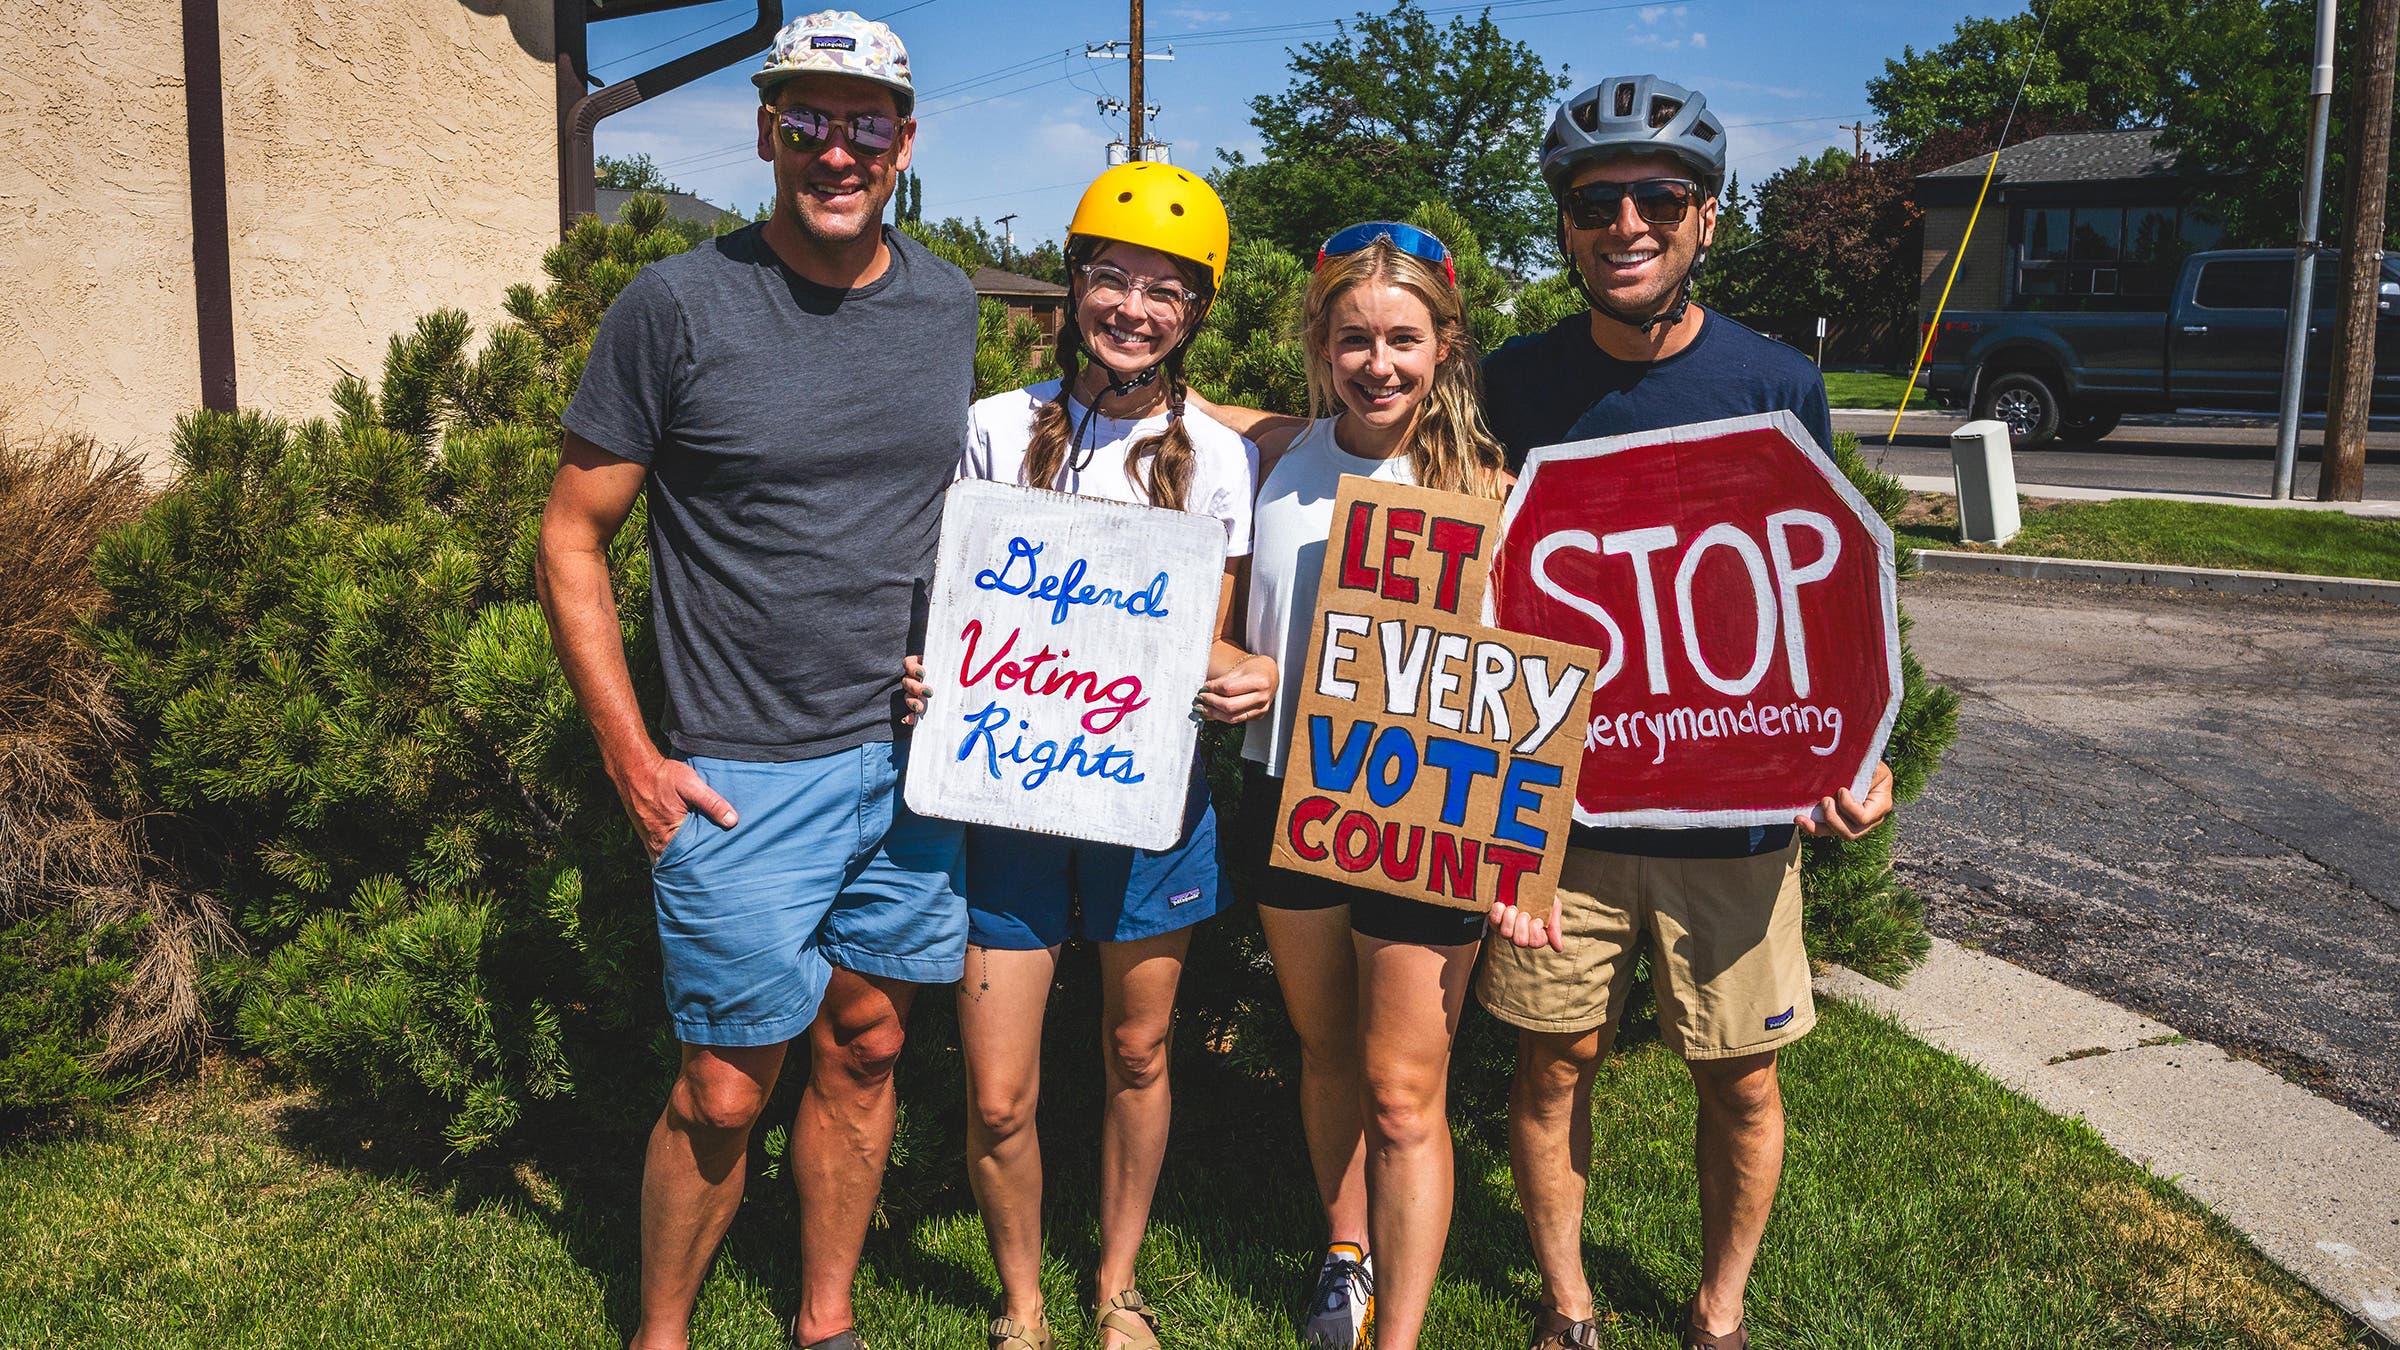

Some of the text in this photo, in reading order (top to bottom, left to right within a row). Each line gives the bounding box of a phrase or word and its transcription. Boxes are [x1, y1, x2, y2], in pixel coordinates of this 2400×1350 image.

[974, 536, 1169, 625] Defend
[1338, 500, 1485, 615] LET
[1531, 508, 1842, 699] STOP
[959, 619, 1151, 734] Voting
[1315, 611, 1590, 755] EVERY
[956, 701, 1146, 790] Rights
[1309, 714, 1563, 850] VOTE
[1288, 795, 1544, 907] COUNT
